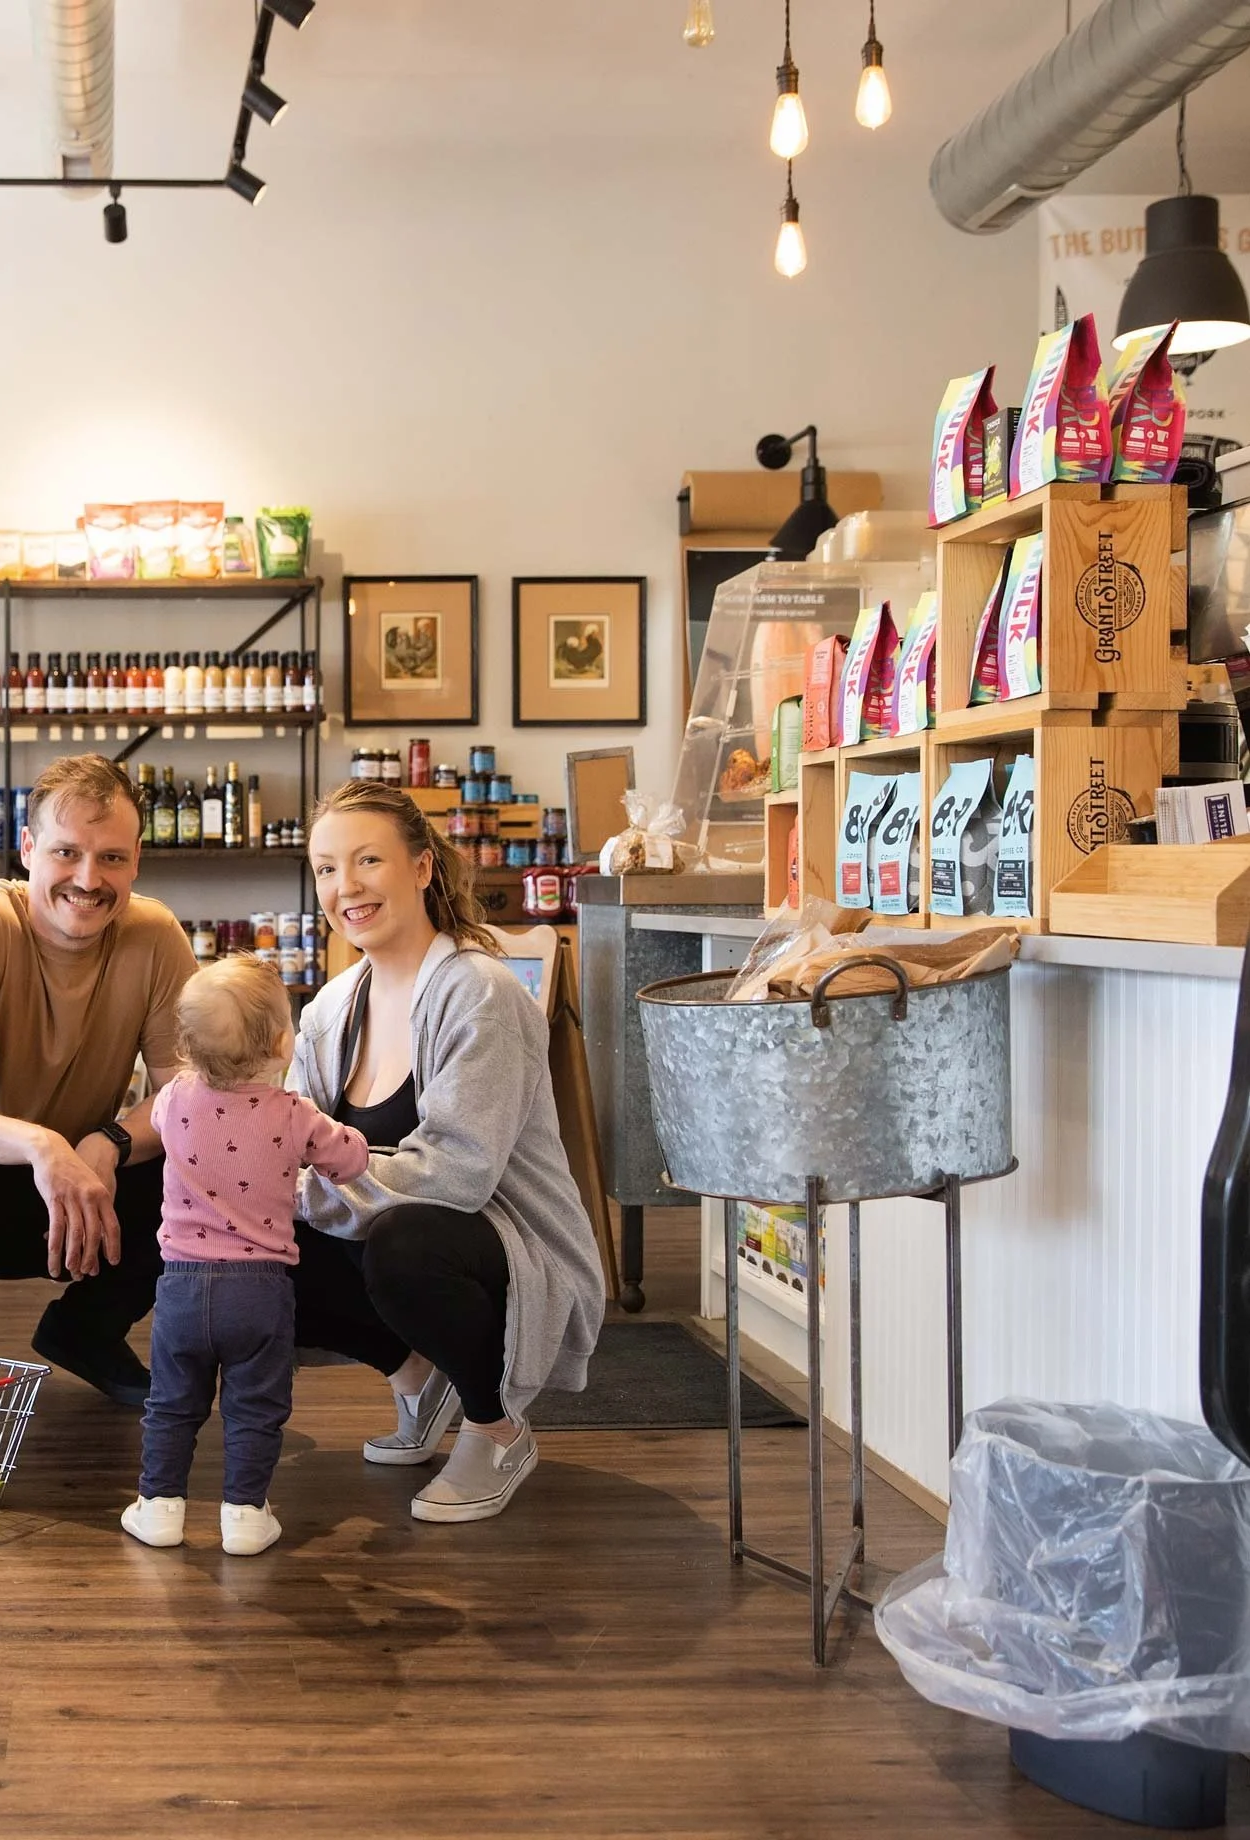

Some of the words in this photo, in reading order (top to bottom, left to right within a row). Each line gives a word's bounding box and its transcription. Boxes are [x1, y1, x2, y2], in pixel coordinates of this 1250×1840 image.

[1048, 229, 1094, 261] THE
[1188, 408, 1225, 419] PORK
[1094, 530, 1118, 603] STREET
[1094, 601, 1122, 664] GRANT
[1085, 756, 1109, 829] STREET
